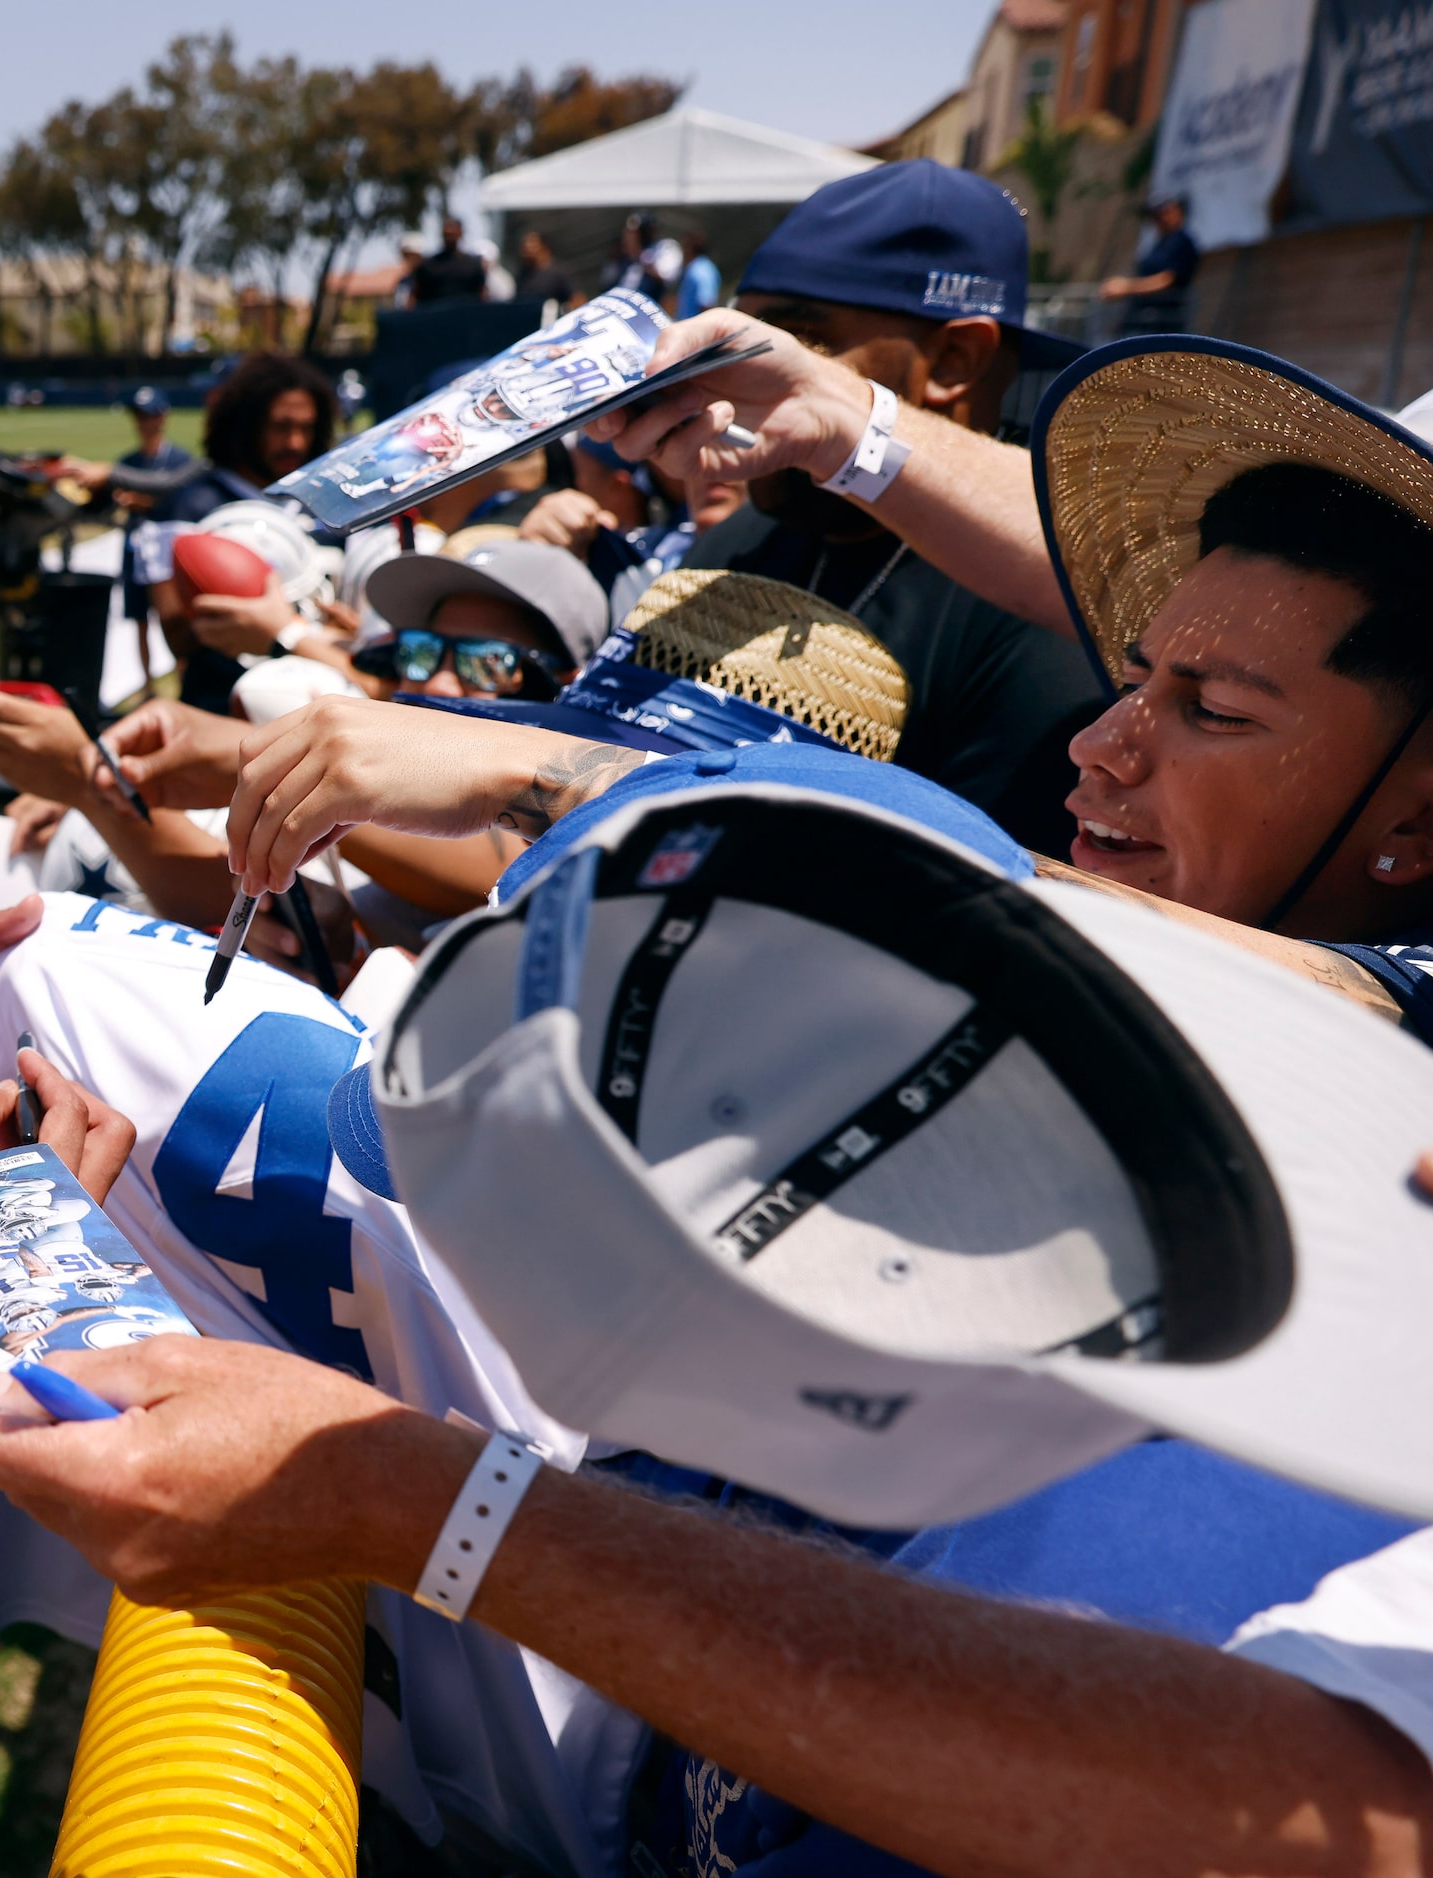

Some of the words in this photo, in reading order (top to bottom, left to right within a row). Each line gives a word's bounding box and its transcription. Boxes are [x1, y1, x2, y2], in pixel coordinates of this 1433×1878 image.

[555, 358, 610, 396] 90
[152, 1012, 377, 1386] 4
[54, 1252, 103, 1273] 15
